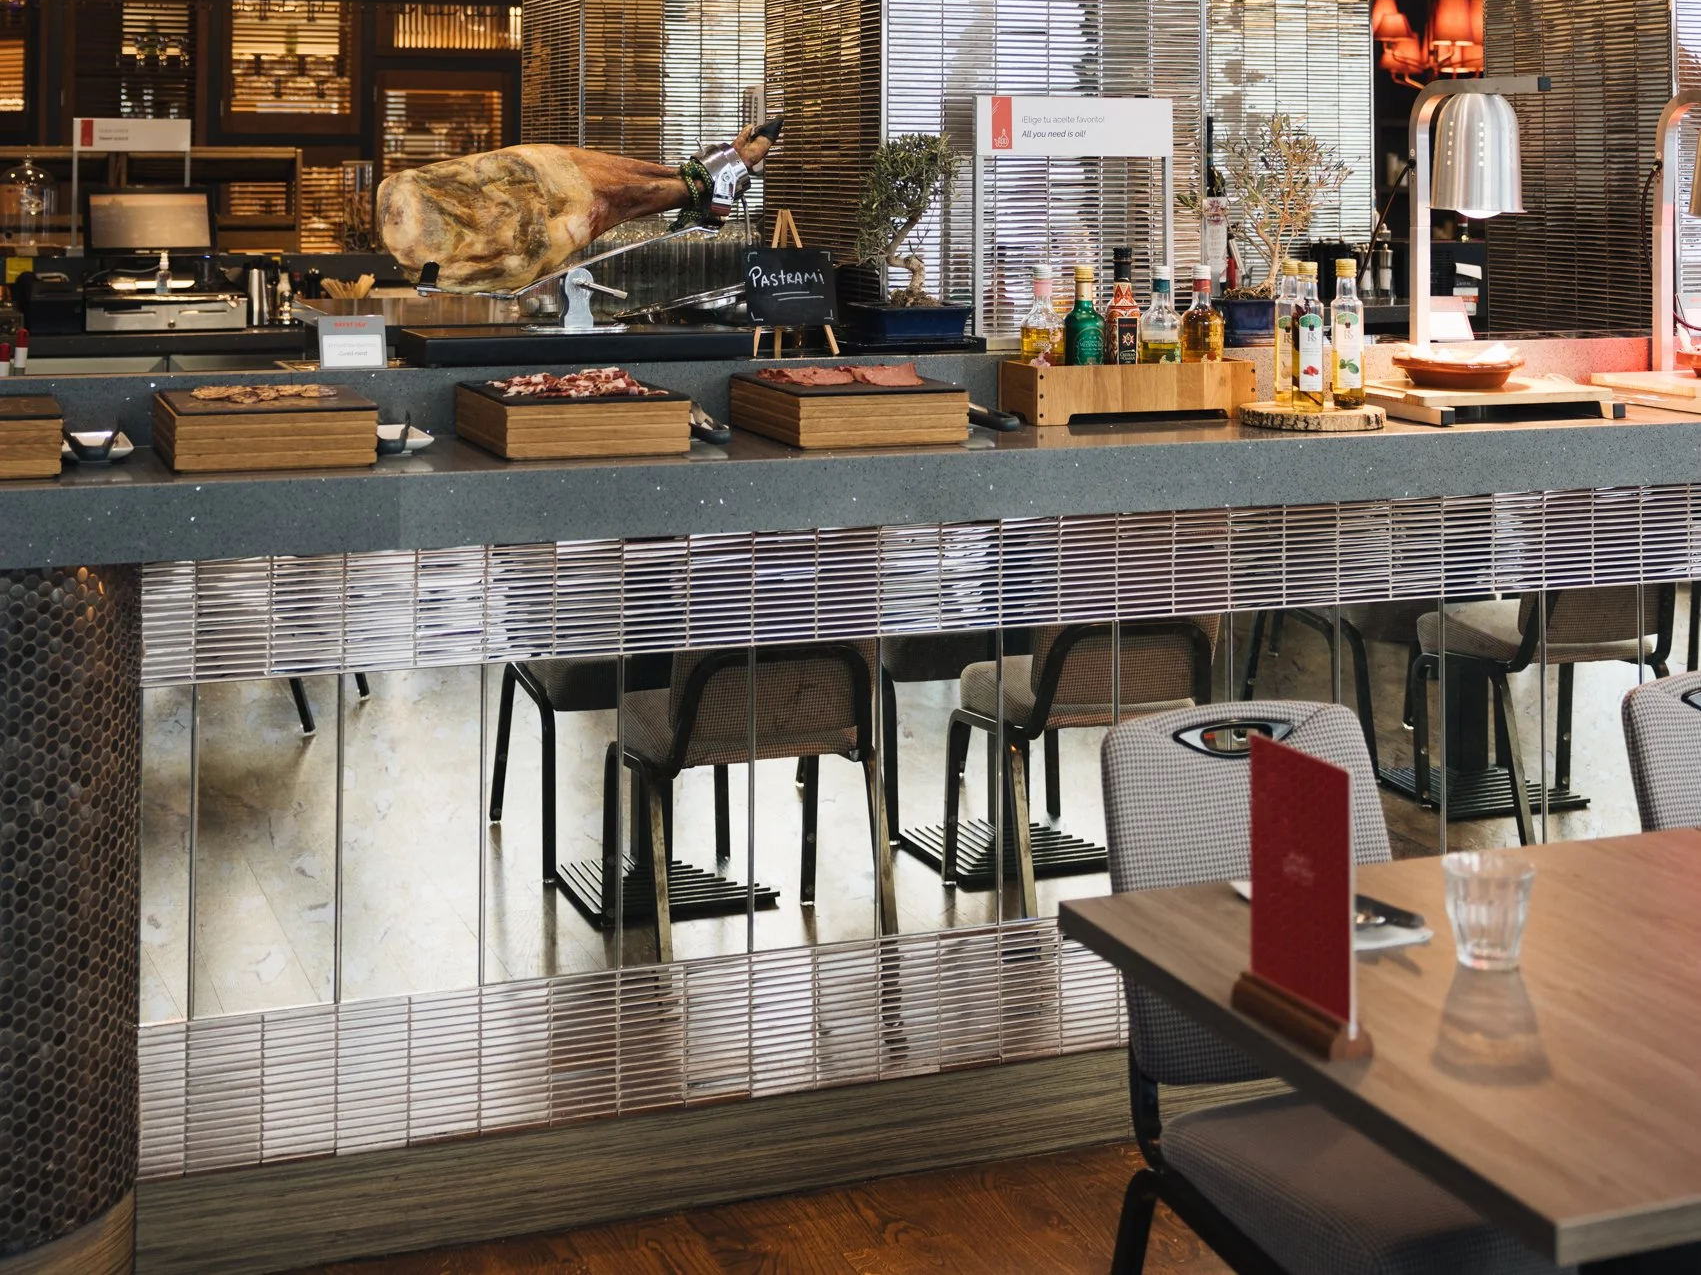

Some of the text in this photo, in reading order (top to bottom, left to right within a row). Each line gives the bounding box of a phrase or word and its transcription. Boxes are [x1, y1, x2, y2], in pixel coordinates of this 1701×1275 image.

[1043, 116, 1051, 124] tu
[1052, 116, 1075, 124] aceite
[1021, 130, 1032, 138] All
[1032, 131, 1046, 139] you
[1047, 130, 1067, 138] need
[1067, 130, 1074, 138] is
